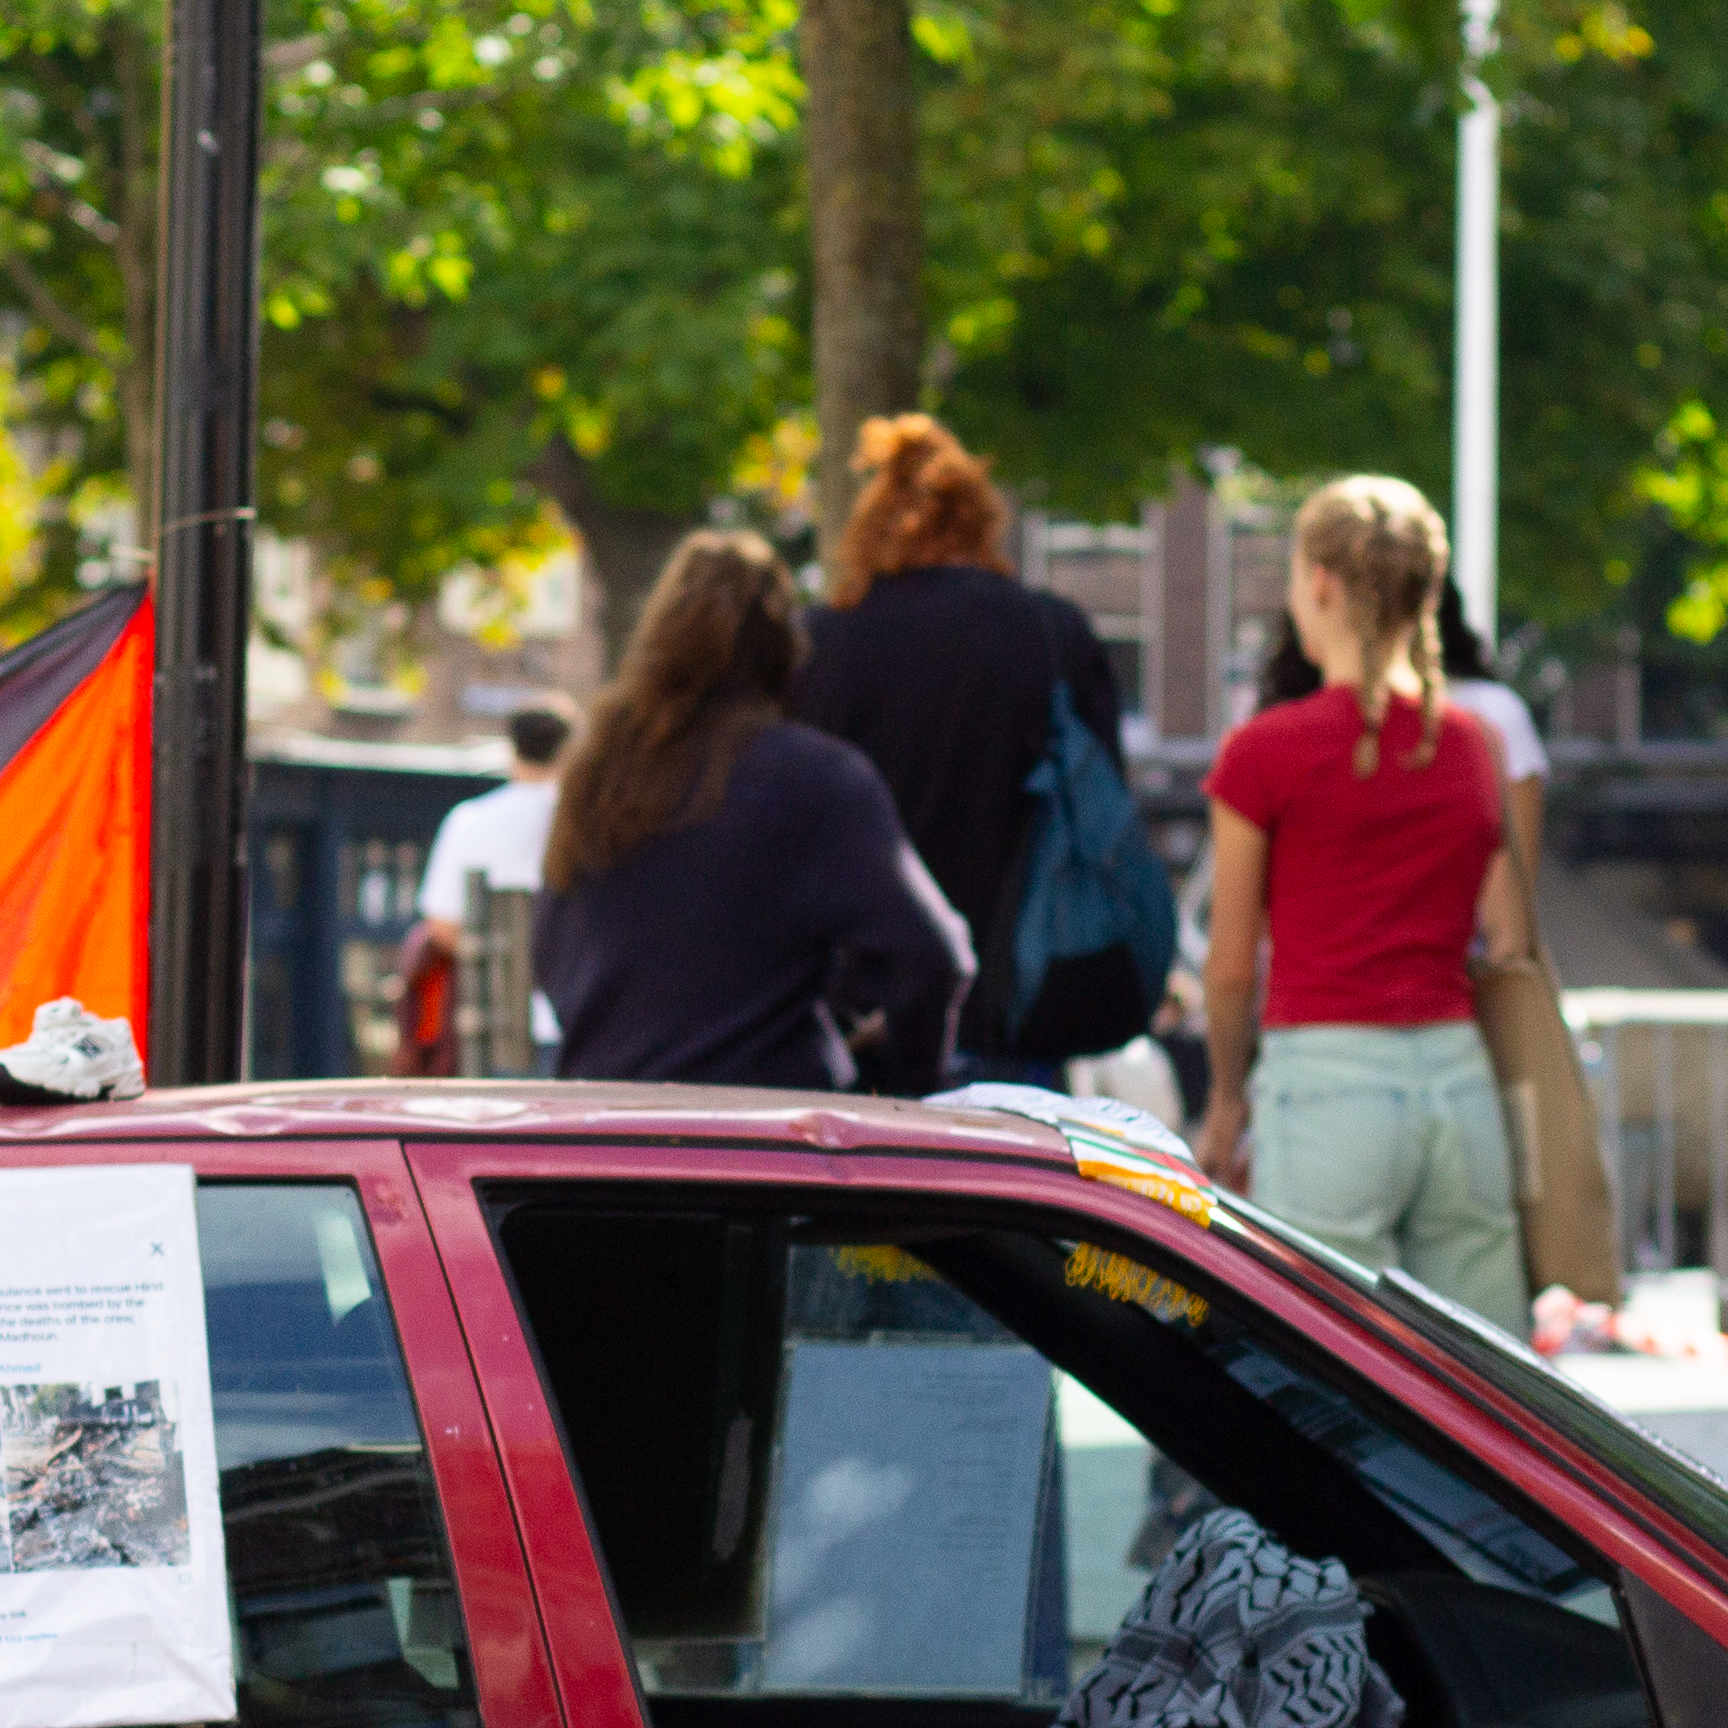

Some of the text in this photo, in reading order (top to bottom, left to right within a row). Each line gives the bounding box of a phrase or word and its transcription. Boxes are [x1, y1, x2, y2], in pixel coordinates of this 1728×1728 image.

[46, 1285, 71, 1296] sent
[75, 1285, 87, 1295] to
[91, 1284, 131, 1294] rescue
[135, 1282, 163, 1292] Hind
[26, 1303, 49, 1311] was
[53, 1299, 104, 1310] bombed
[107, 1299, 121, 1310] by
[125, 1298, 144, 1307] the
[19, 1316, 62, 1326] deaths
[65, 1315, 77, 1326] of
[80, 1314, 100, 1325] the
